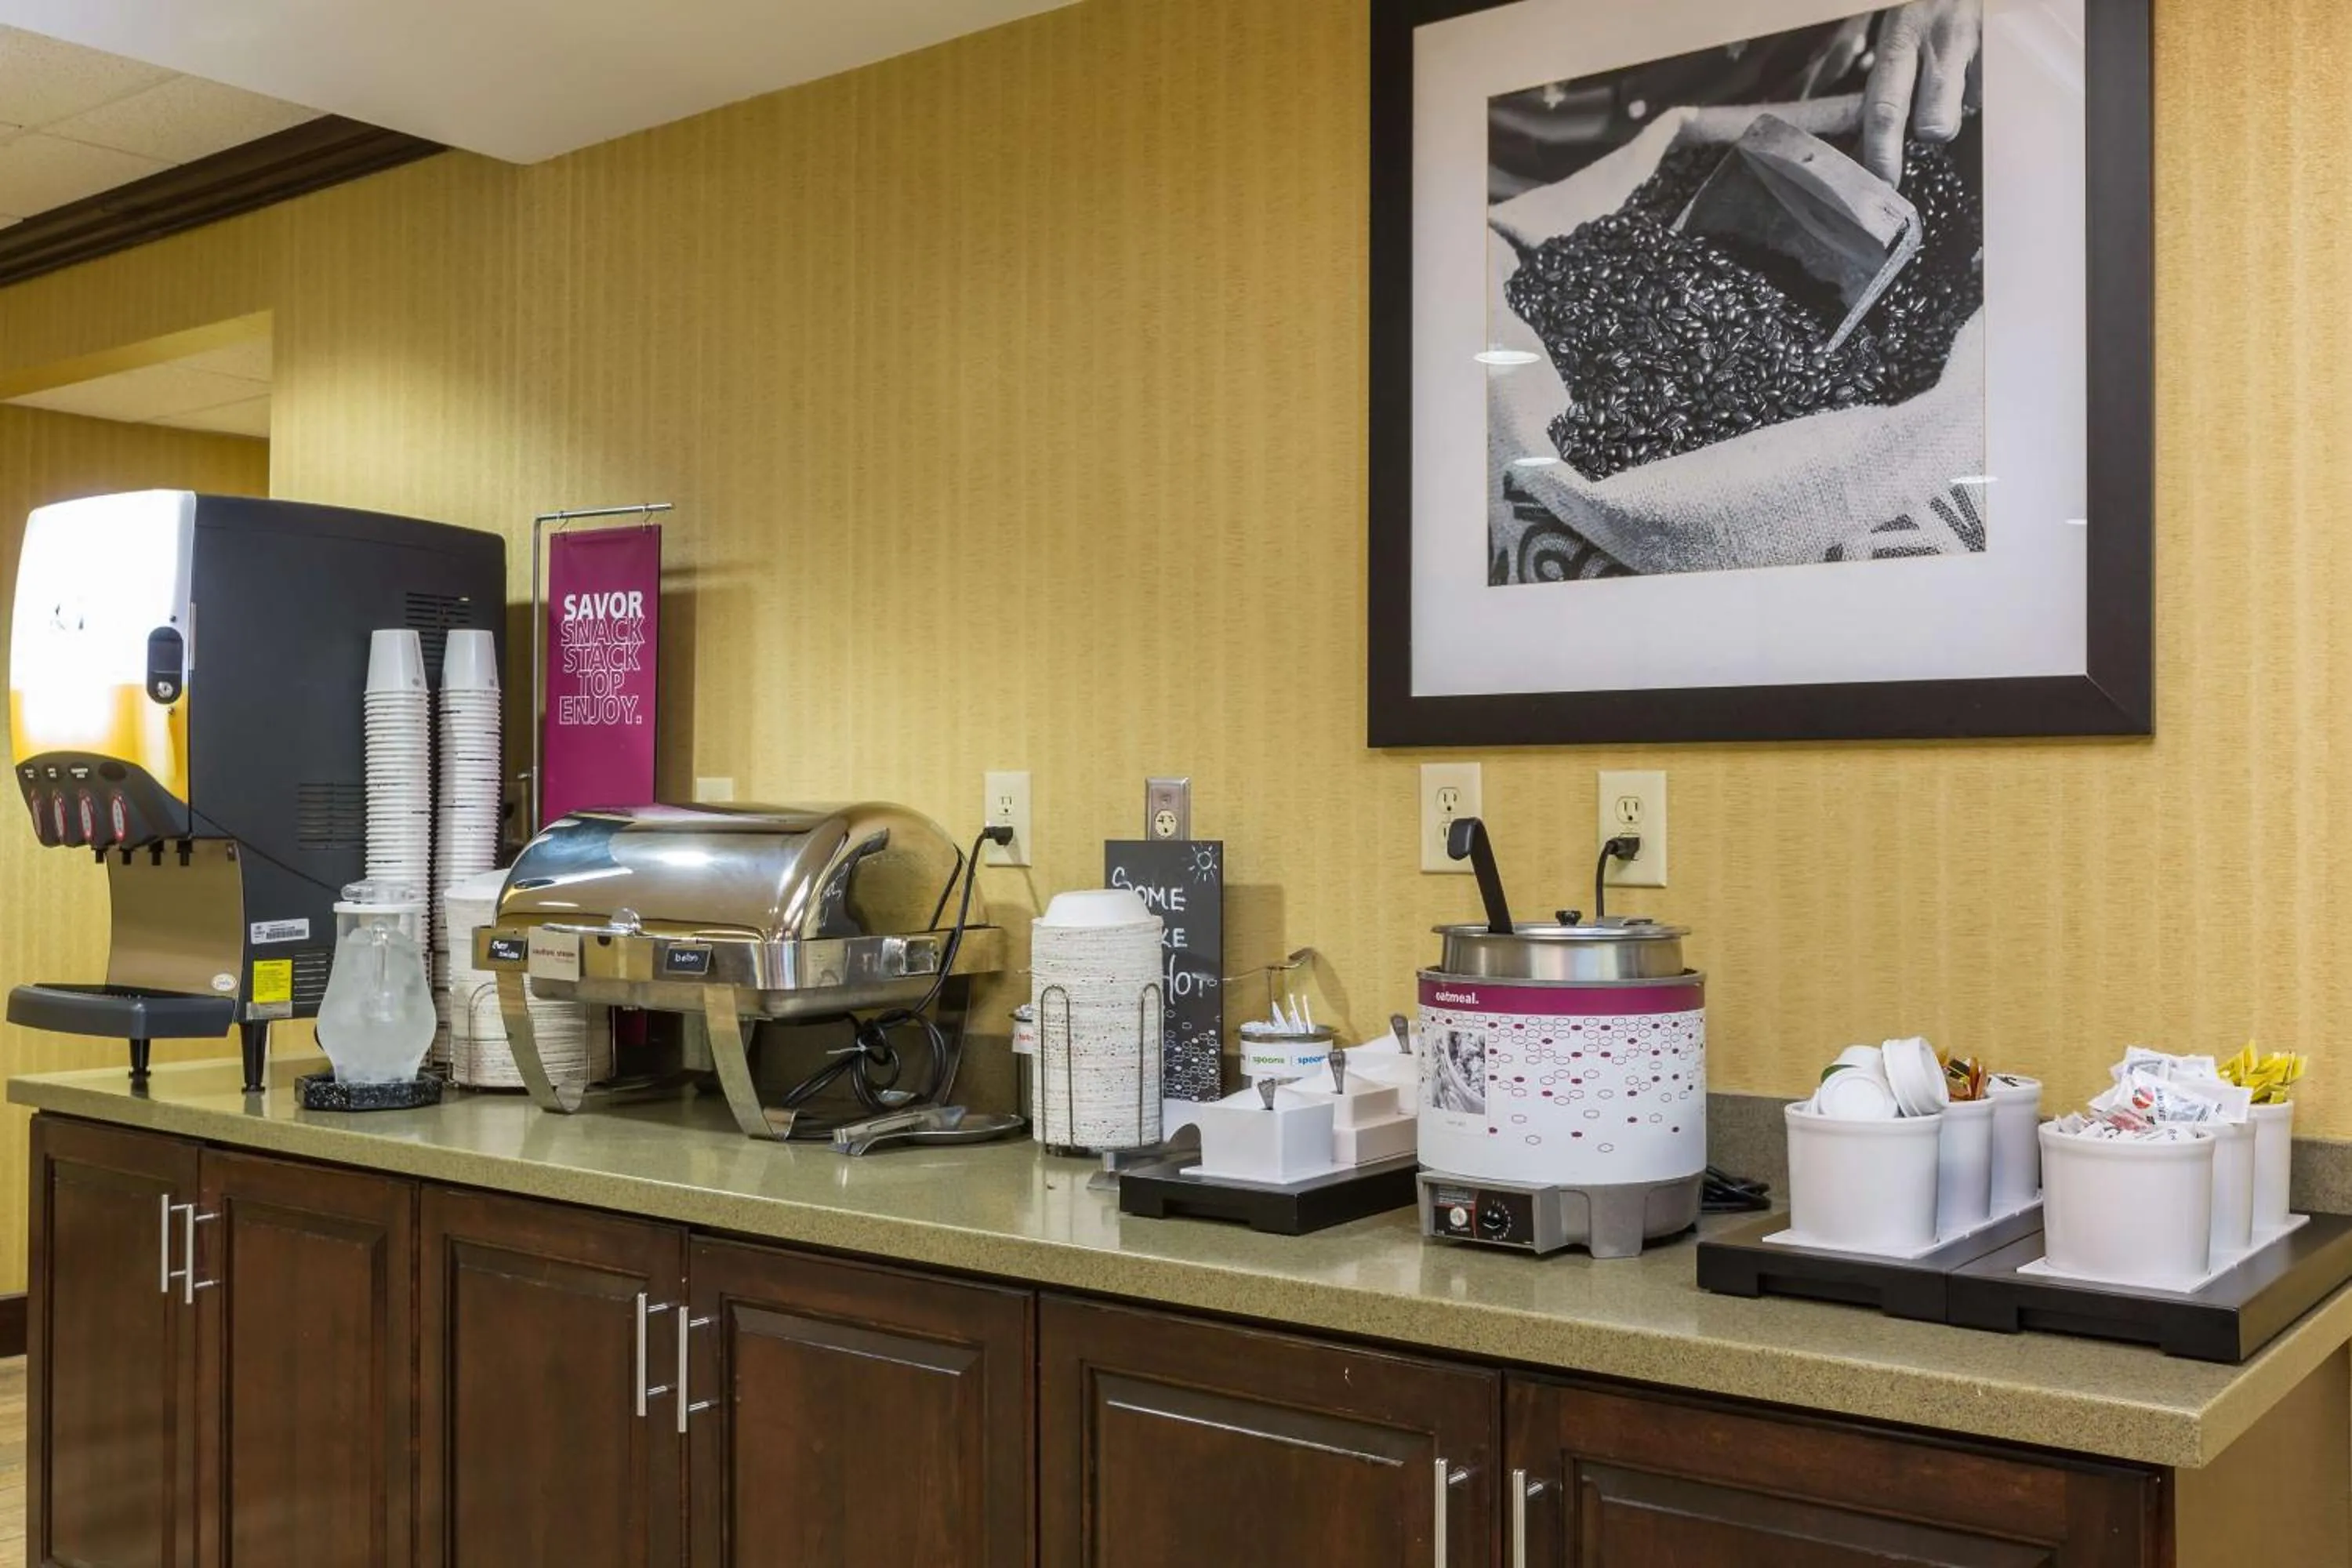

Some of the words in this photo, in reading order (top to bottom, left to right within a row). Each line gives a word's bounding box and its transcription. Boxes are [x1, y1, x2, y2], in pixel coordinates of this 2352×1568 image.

[564, 591, 644, 620] SAVOR
[561, 615, 645, 646] SNACK
[563, 643, 641, 673] STACK
[577, 669, 625, 698] TOP
[559, 695, 642, 725] ENJOY.
[1163, 953, 1215, 1005] HOT
[1436, 990, 1479, 1004] oatmeal.
[1253, 1055, 1284, 1065] spoons
